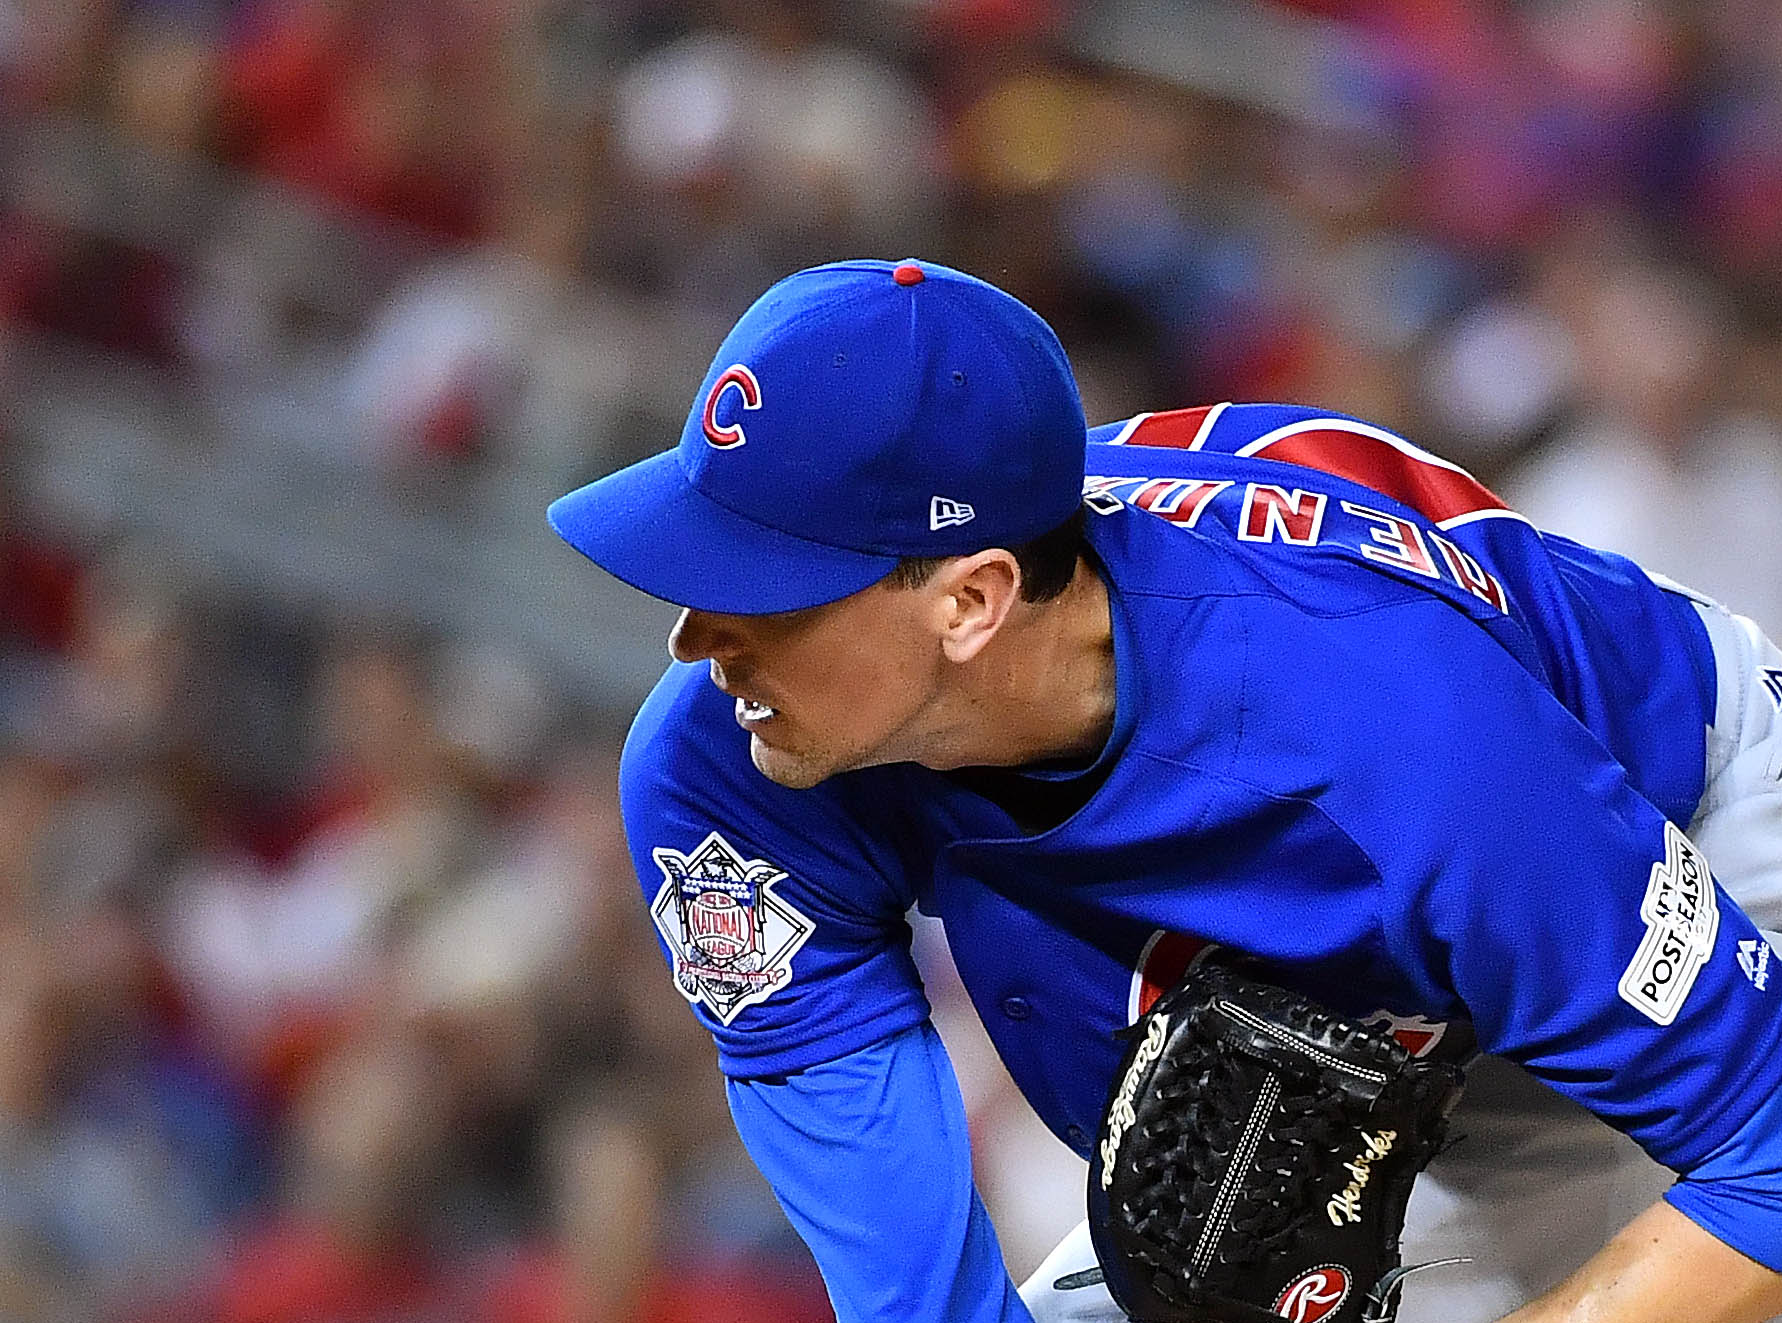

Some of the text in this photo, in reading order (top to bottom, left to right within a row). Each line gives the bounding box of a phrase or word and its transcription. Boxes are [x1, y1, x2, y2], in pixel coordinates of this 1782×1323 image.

[703, 363, 762, 450] C
[692, 904, 745, 941] NATIONAL
[1327, 1129, 1397, 1228] Hendricks
